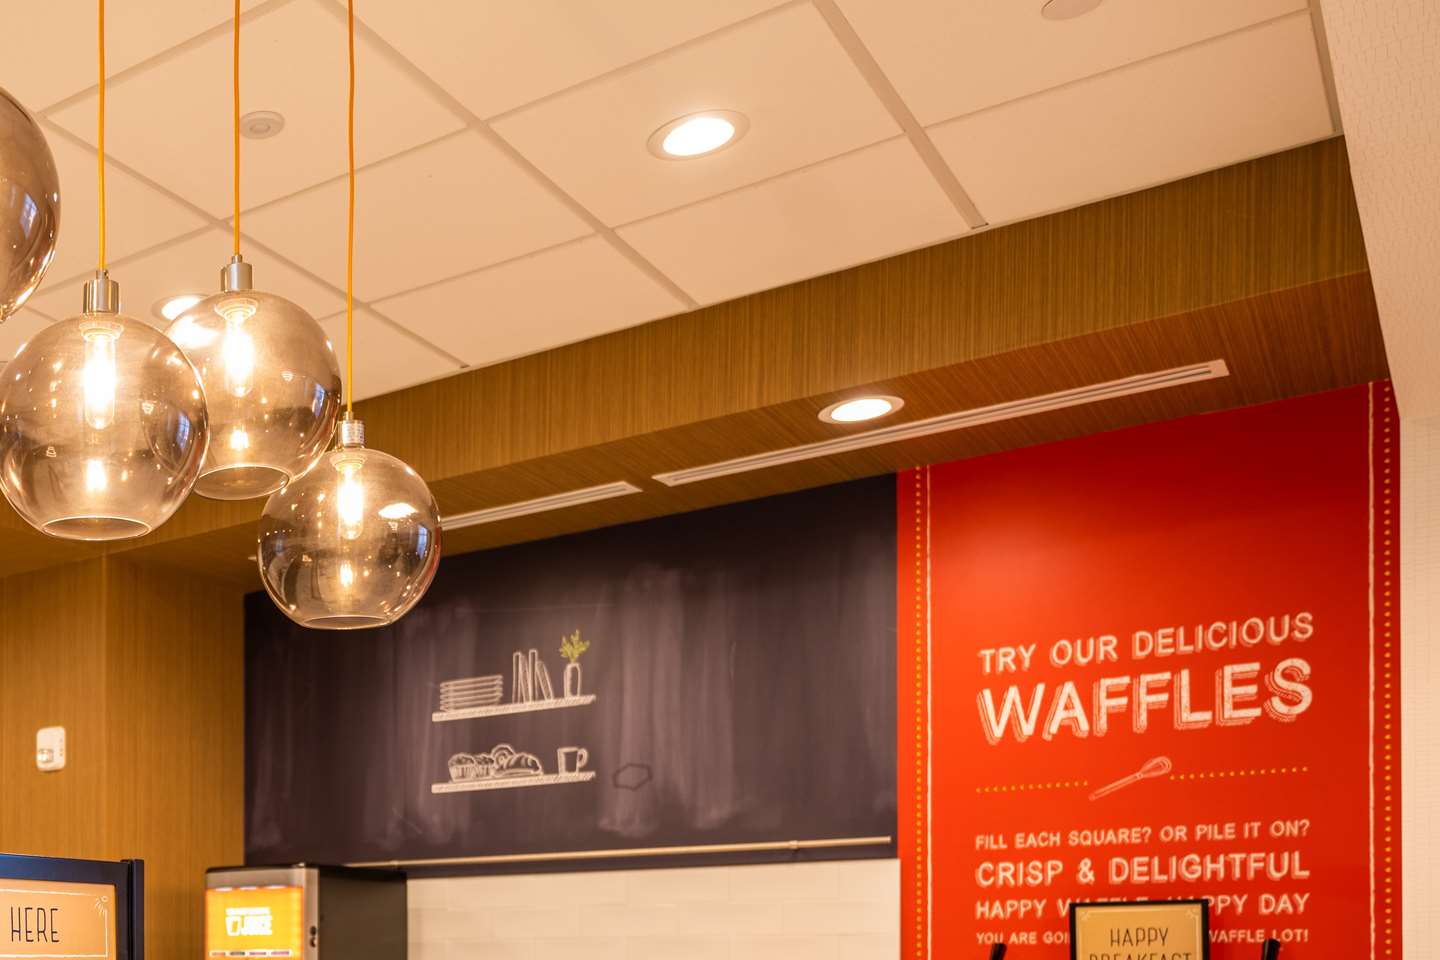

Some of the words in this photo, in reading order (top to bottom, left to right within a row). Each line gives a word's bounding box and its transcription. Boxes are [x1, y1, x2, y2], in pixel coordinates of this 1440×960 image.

[977, 644, 1036, 675] TRY
[1050, 635, 1118, 668] OUR
[1132, 612, 1314, 660] DELICIOUS
[977, 658, 1313, 746] WAFFLES
[975, 834, 1007, 849] FILL
[1015, 832, 1060, 848] EACH
[1068, 826, 1152, 846] SQUARE?
[1160, 825, 1187, 842] OR
[1195, 823, 1236, 841] PILE
[1244, 821, 1261, 838] IT
[1270, 819, 1311, 837] ON?
[975, 860, 1064, 887] CRISP
[1078, 858, 1095, 884] &
[1109, 851, 1311, 884] DELIGHTFUL
[975, 898, 1047, 920] HAPPY
[1259, 892, 1310, 915] DAY
[10, 906, 60, 943] HERE
[976, 931, 1004, 944] YOU
[1009, 931, 1037, 944] ARE
[1272, 928, 1309, 943] LOT!
[1109, 927, 1168, 947] HAPPY
